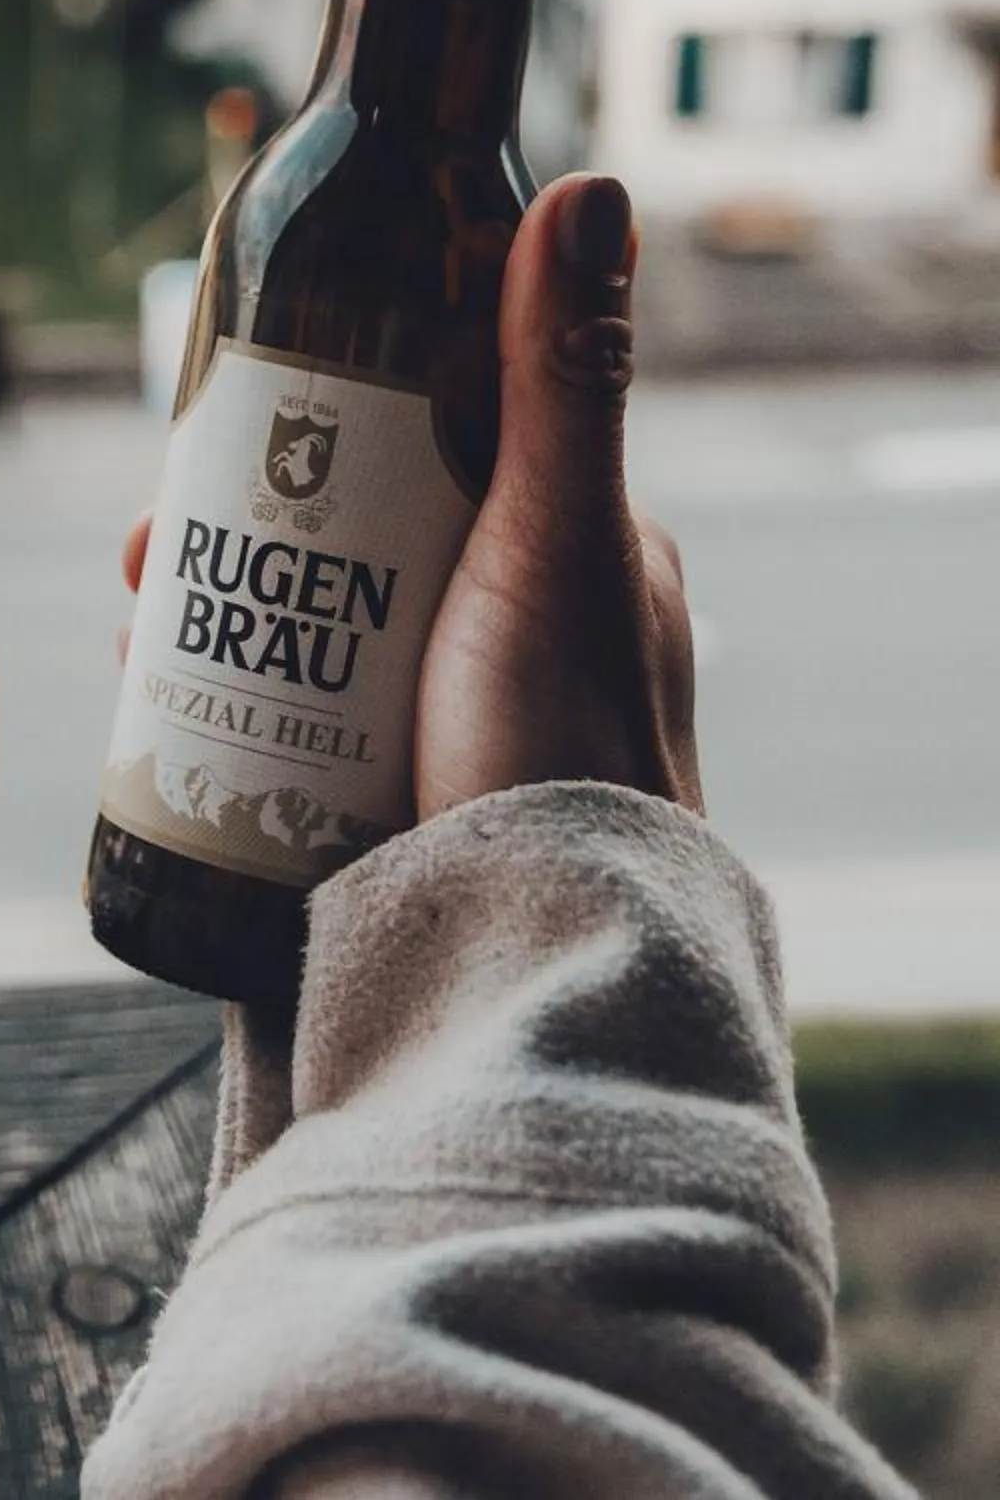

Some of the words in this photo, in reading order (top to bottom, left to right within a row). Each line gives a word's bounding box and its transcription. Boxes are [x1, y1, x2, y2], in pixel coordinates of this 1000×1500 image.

[175, 517, 398, 631] RUGEN
[174, 589, 362, 693] BRÄU
[143, 675, 264, 738] SPEZIAL
[271, 713, 376, 764] HELL
